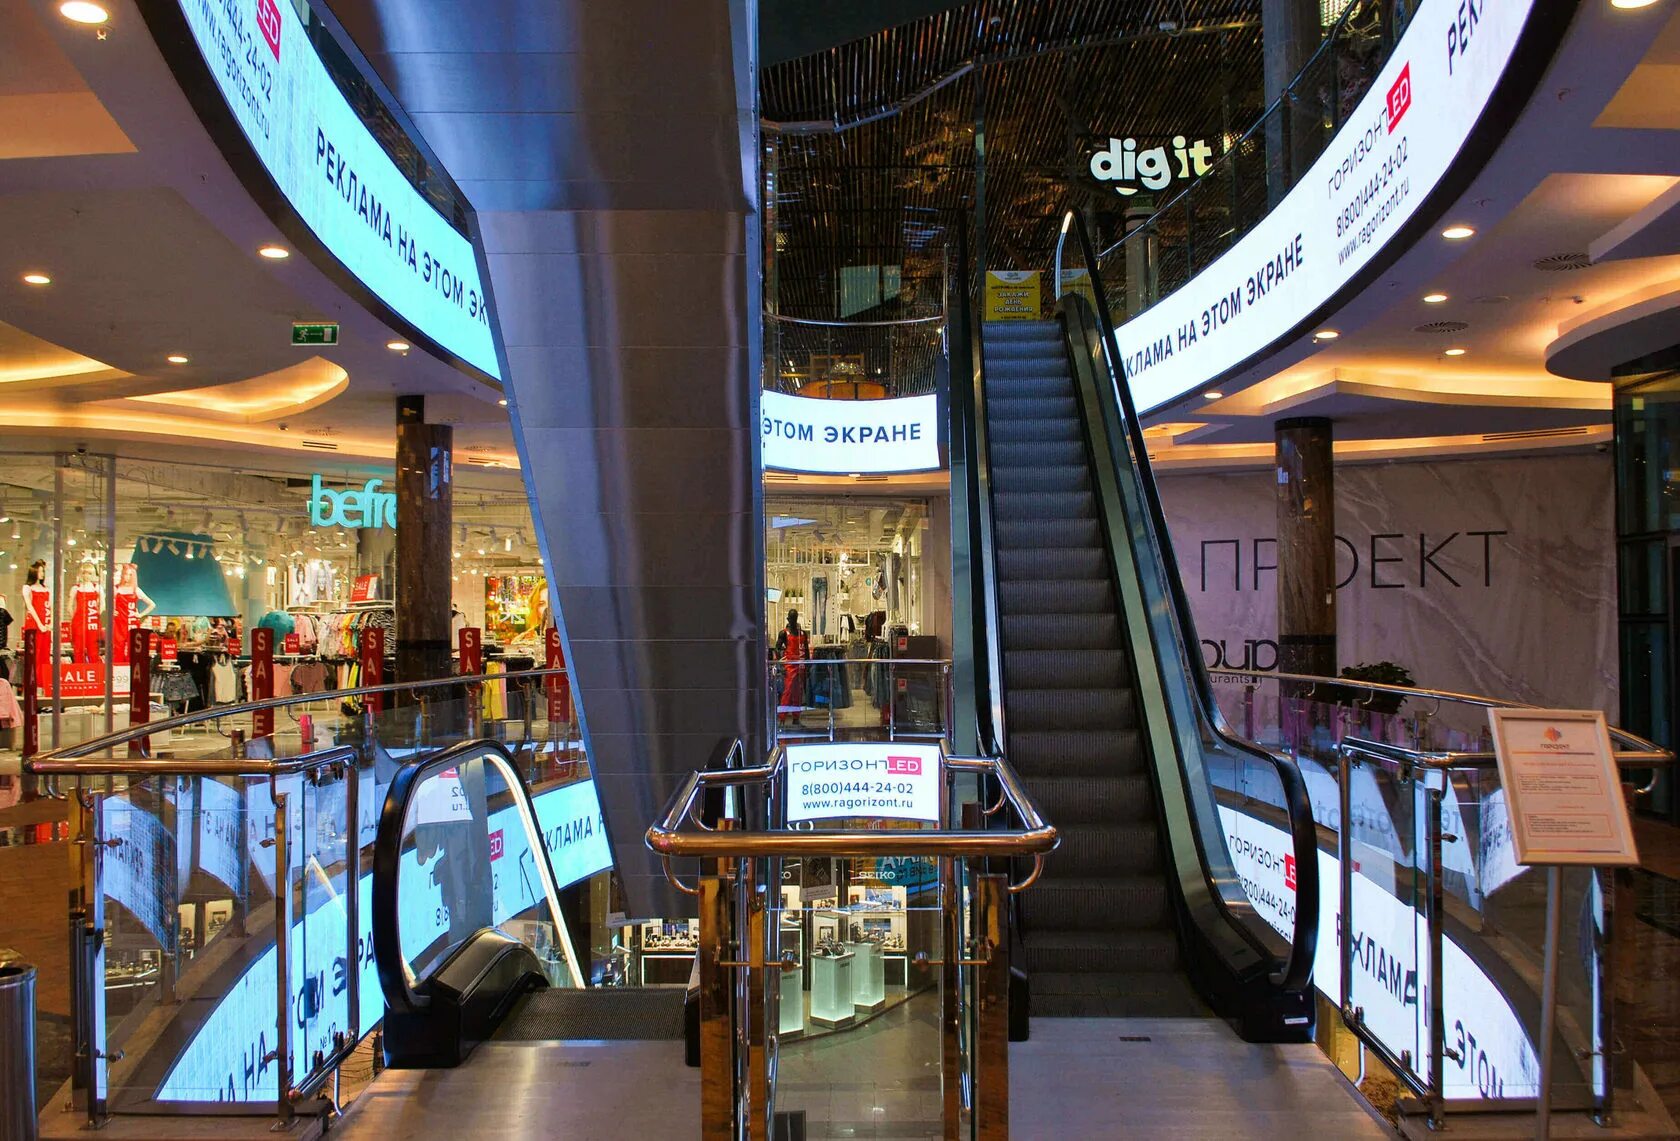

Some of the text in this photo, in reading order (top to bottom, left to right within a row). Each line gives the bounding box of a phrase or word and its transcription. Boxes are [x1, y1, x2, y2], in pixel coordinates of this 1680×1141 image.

[1387, 77, 1410, 122] LED
[1090, 135, 1213, 190] dig it
[1336, 136, 1408, 238] 8(800)444-24-02
[316, 126, 393, 248] РЕКЛАМА
[399, 224, 417, 274] НА
[423, 251, 464, 309] ЭТОМ
[1338, 177, 1410, 266] www.ragorizont.ru
[1124, 232, 1304, 380] КЛАМА НА ЭТОМ ЭКРАНЕ
[763, 417, 921, 443] ЭТОМ ЭКРАНЕ
[88, 600, 98, 631] SALE
[60, 670, 96, 682] ALE
[1210, 674, 1249, 684] urants
[888, 761, 919, 771] LED
[802, 782, 913, 795] 8(800)444-24-02
[803, 797, 913, 809] www.ragorizont.ru
[544, 816, 593, 853] КЛАМА
[859, 871, 896, 879] SEIKO
